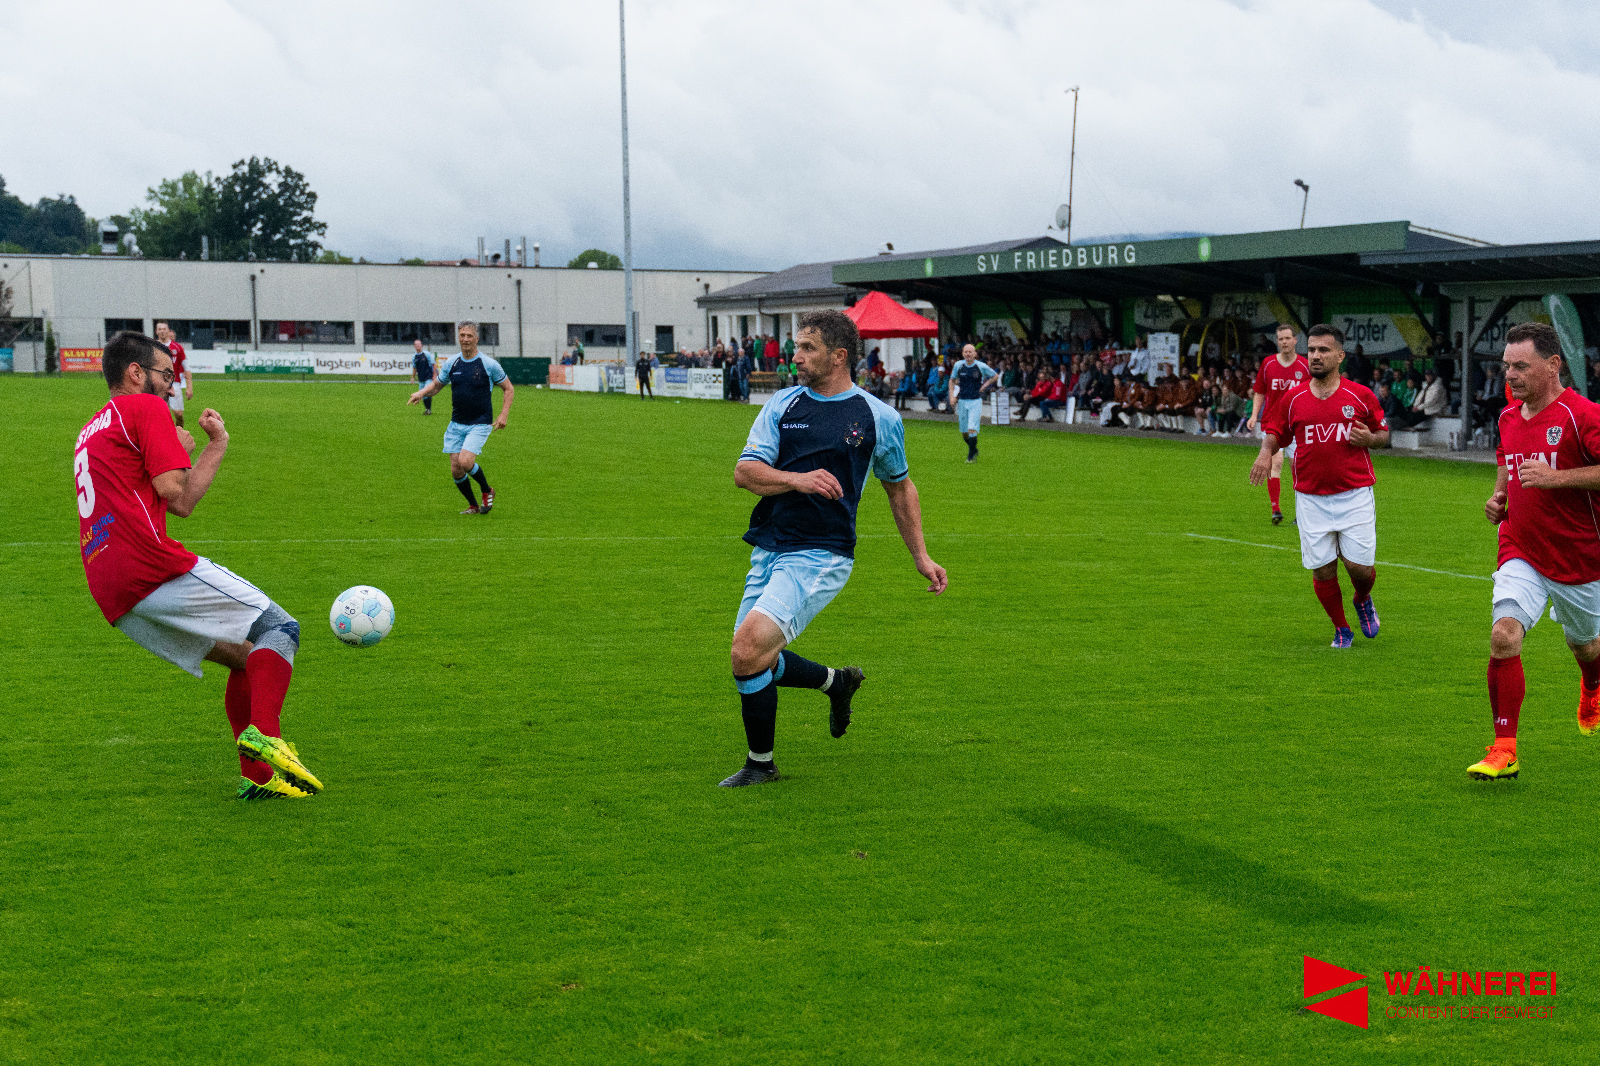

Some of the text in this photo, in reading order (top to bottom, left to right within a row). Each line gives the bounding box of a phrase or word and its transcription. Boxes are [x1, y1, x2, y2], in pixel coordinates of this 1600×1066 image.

[977, 244, 1136, 272] SV FRIEDBURG
[1344, 317, 1387, 345] Zipfer
[316, 358, 413, 371] lugstein lugstein
[1271, 378, 1301, 391] EVN
[75, 408, 112, 450] STRIA
[1304, 422, 1353, 445] EVN
[74, 447, 96, 519] 3
